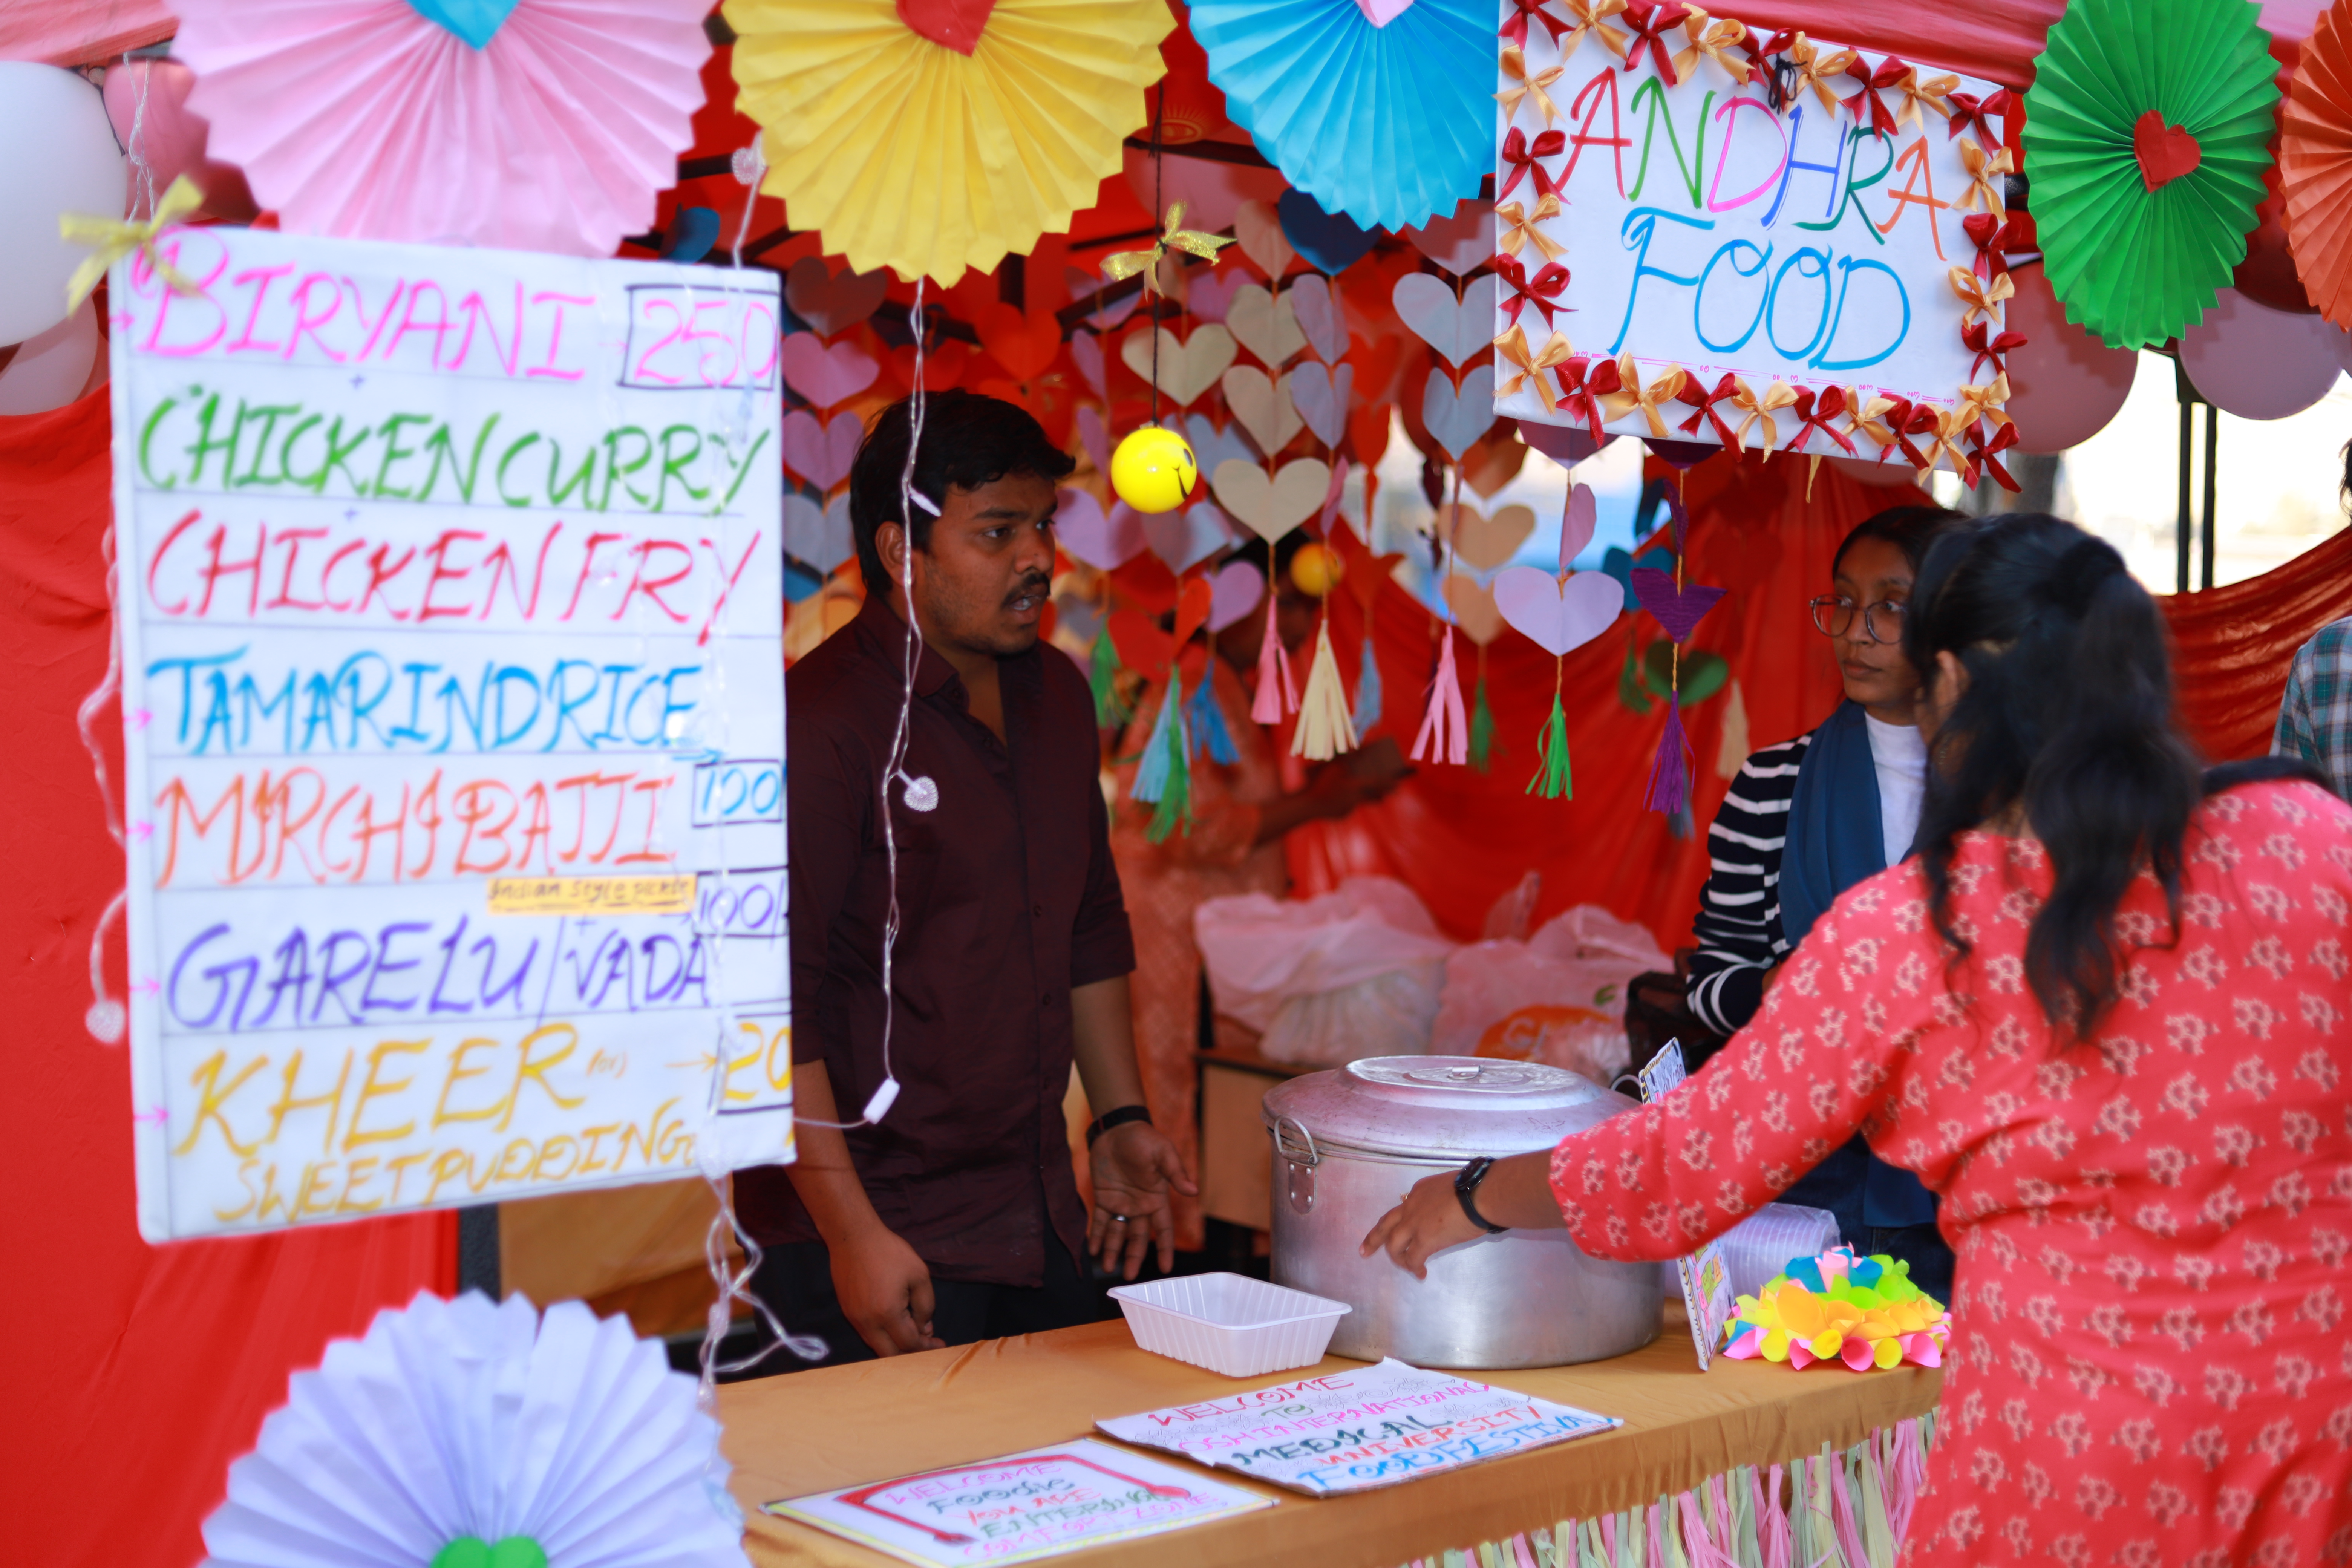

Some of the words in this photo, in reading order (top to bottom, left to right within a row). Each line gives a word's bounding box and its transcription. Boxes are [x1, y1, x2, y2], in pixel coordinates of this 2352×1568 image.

[1553, 65, 1951, 261] ANDHRA
[132, 226, 596, 381] BIRYANI
[1607, 206, 1911, 370] FOOD
[138, 385, 501, 506] CHICKEN
[496, 420, 771, 517] CURRY
[146, 509, 563, 623] CHICKEN
[558, 530, 762, 647] FRY
[146, 643, 541, 755] TAMARIND
[170, 1021, 588, 1157] KHEER
[213, 1148, 433, 1224] SWEET
[1147, 1375, 1355, 1427] WELCOME
[1178, 1432, 1258, 1452] OSH
[1251, 1381, 1490, 1440] INTERNATIONAL
[1260, 1404, 1314, 1419] TO
[1312, 1404, 1542, 1465] UNIVERSITY
[1231, 1415, 1455, 1466] MEDICAL
[1295, 1450, 1445, 1491] FOOD
[884, 1462, 1063, 1505] WELCOME
